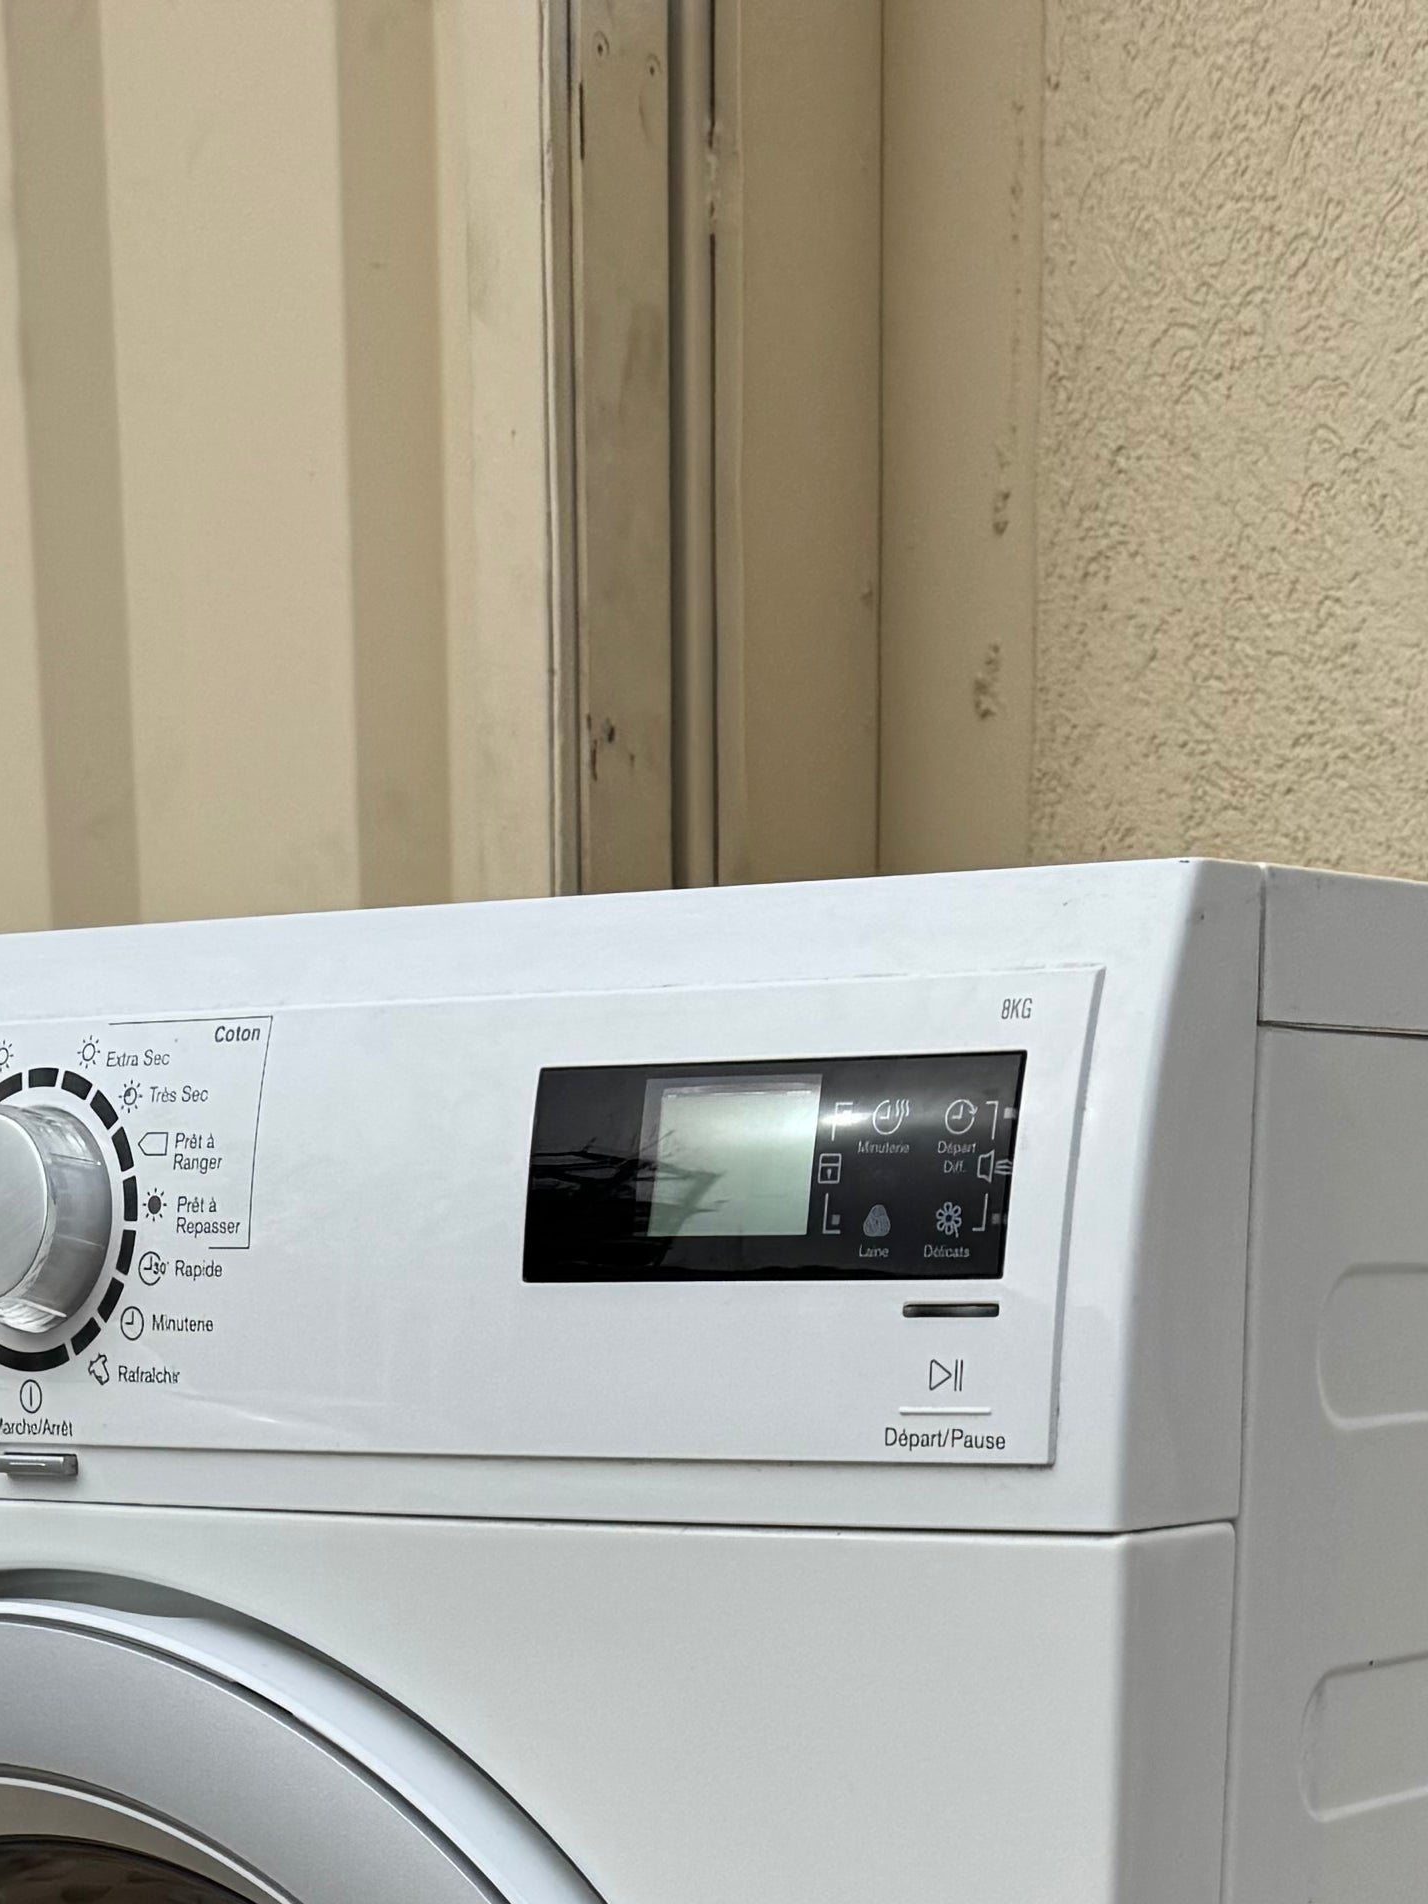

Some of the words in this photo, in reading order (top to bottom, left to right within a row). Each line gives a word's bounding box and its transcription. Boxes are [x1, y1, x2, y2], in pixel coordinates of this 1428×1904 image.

[1000, 998, 1033, 1020] 8KG
[214, 1025, 261, 1043] Coton
[105, 1050, 139, 1067] Extra
[143, 1048, 171, 1067] Sec
[149, 1086, 177, 1104] Très
[181, 1084, 209, 1103] Sec
[206, 1133, 215, 1149] à
[172, 1153, 223, 1175] Ranger
[208, 1197, 217, 1213] à
[175, 1217, 241, 1238] Repasser
[174, 1259, 223, 1281] Rapide
[883, 1426, 1007, 1453] Départ/Pause
